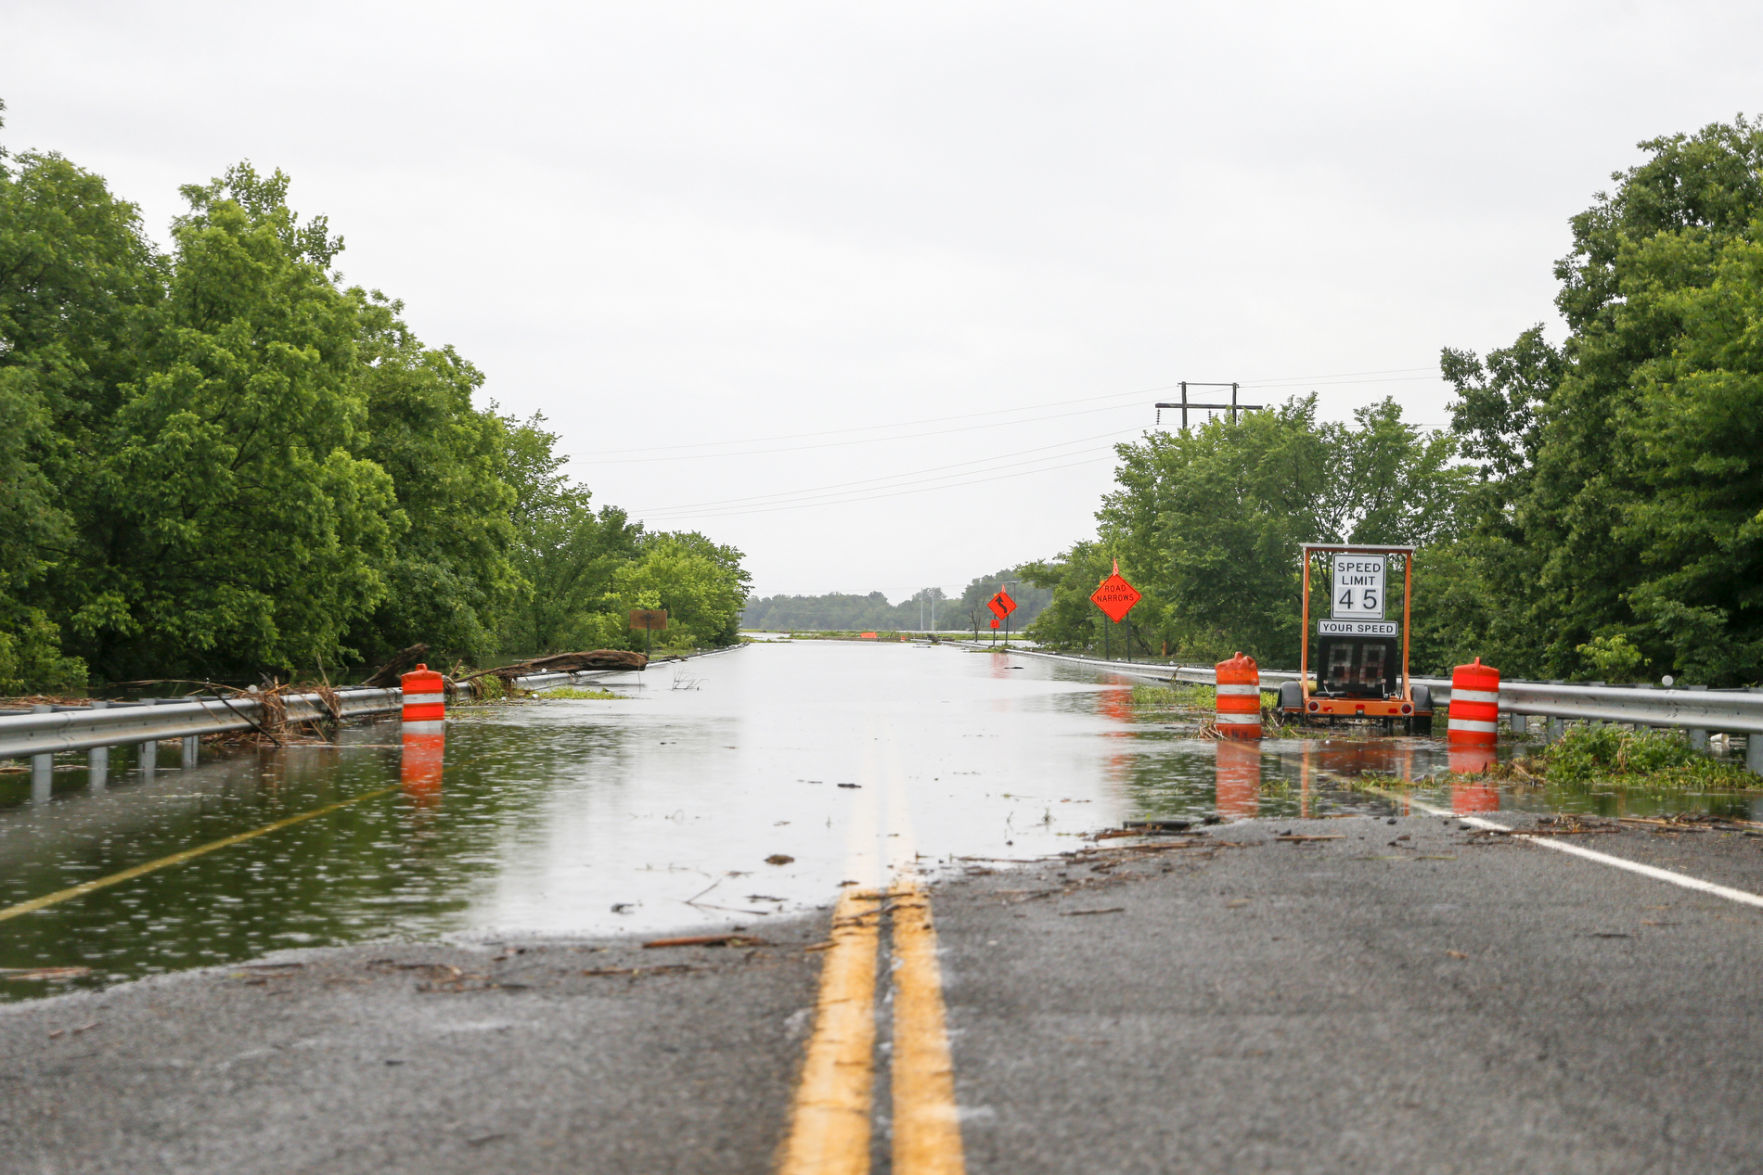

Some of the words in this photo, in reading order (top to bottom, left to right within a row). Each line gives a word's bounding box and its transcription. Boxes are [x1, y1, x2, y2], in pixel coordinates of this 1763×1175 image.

[1337, 562, 1381, 573] SPEED
[1341, 576, 1376, 586] LIMIT
[1104, 584, 1127, 592] ROAD
[1096, 593, 1134, 602] NARROWS
[1338, 589, 1378, 610] 45
[1322, 623, 1353, 632] YOUR
[1357, 624, 1394, 633] SPEED
